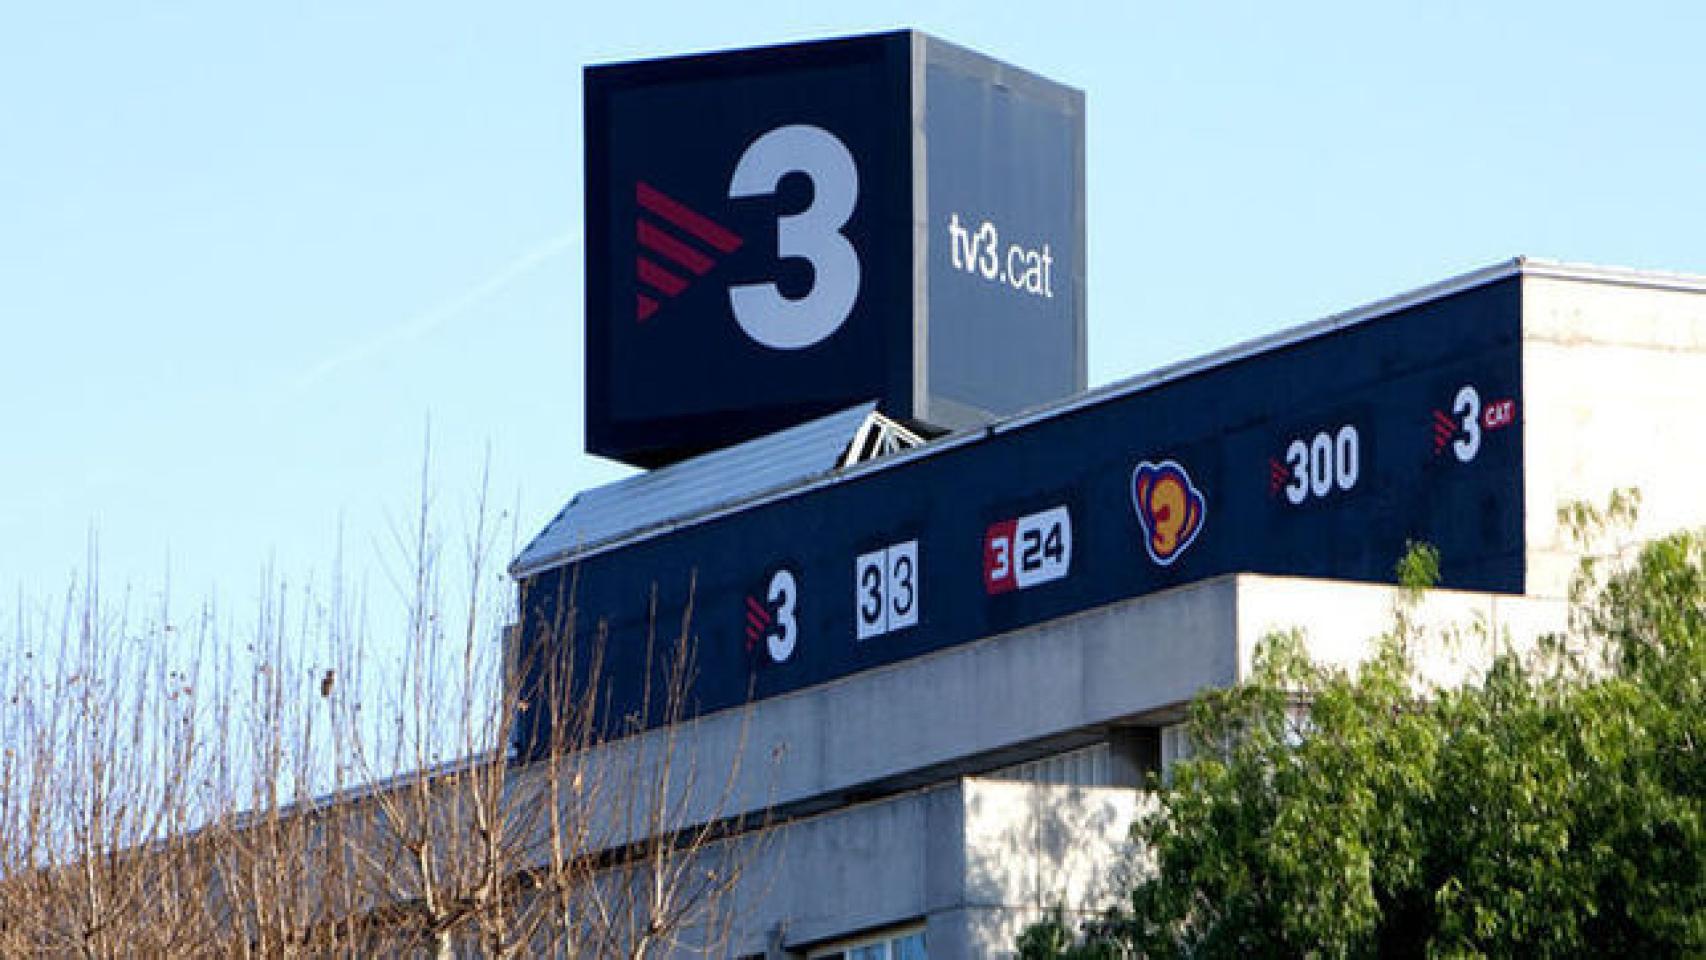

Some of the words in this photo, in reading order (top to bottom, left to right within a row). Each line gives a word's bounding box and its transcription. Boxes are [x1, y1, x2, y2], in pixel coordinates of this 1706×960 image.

[728, 124, 860, 350] 3
[947, 212, 1054, 298] tv3.cat
[1285, 424, 1359, 504] 300
[1453, 385, 1480, 462] 3
[1485, 401, 1512, 425] CAT
[766, 569, 798, 663] 3
